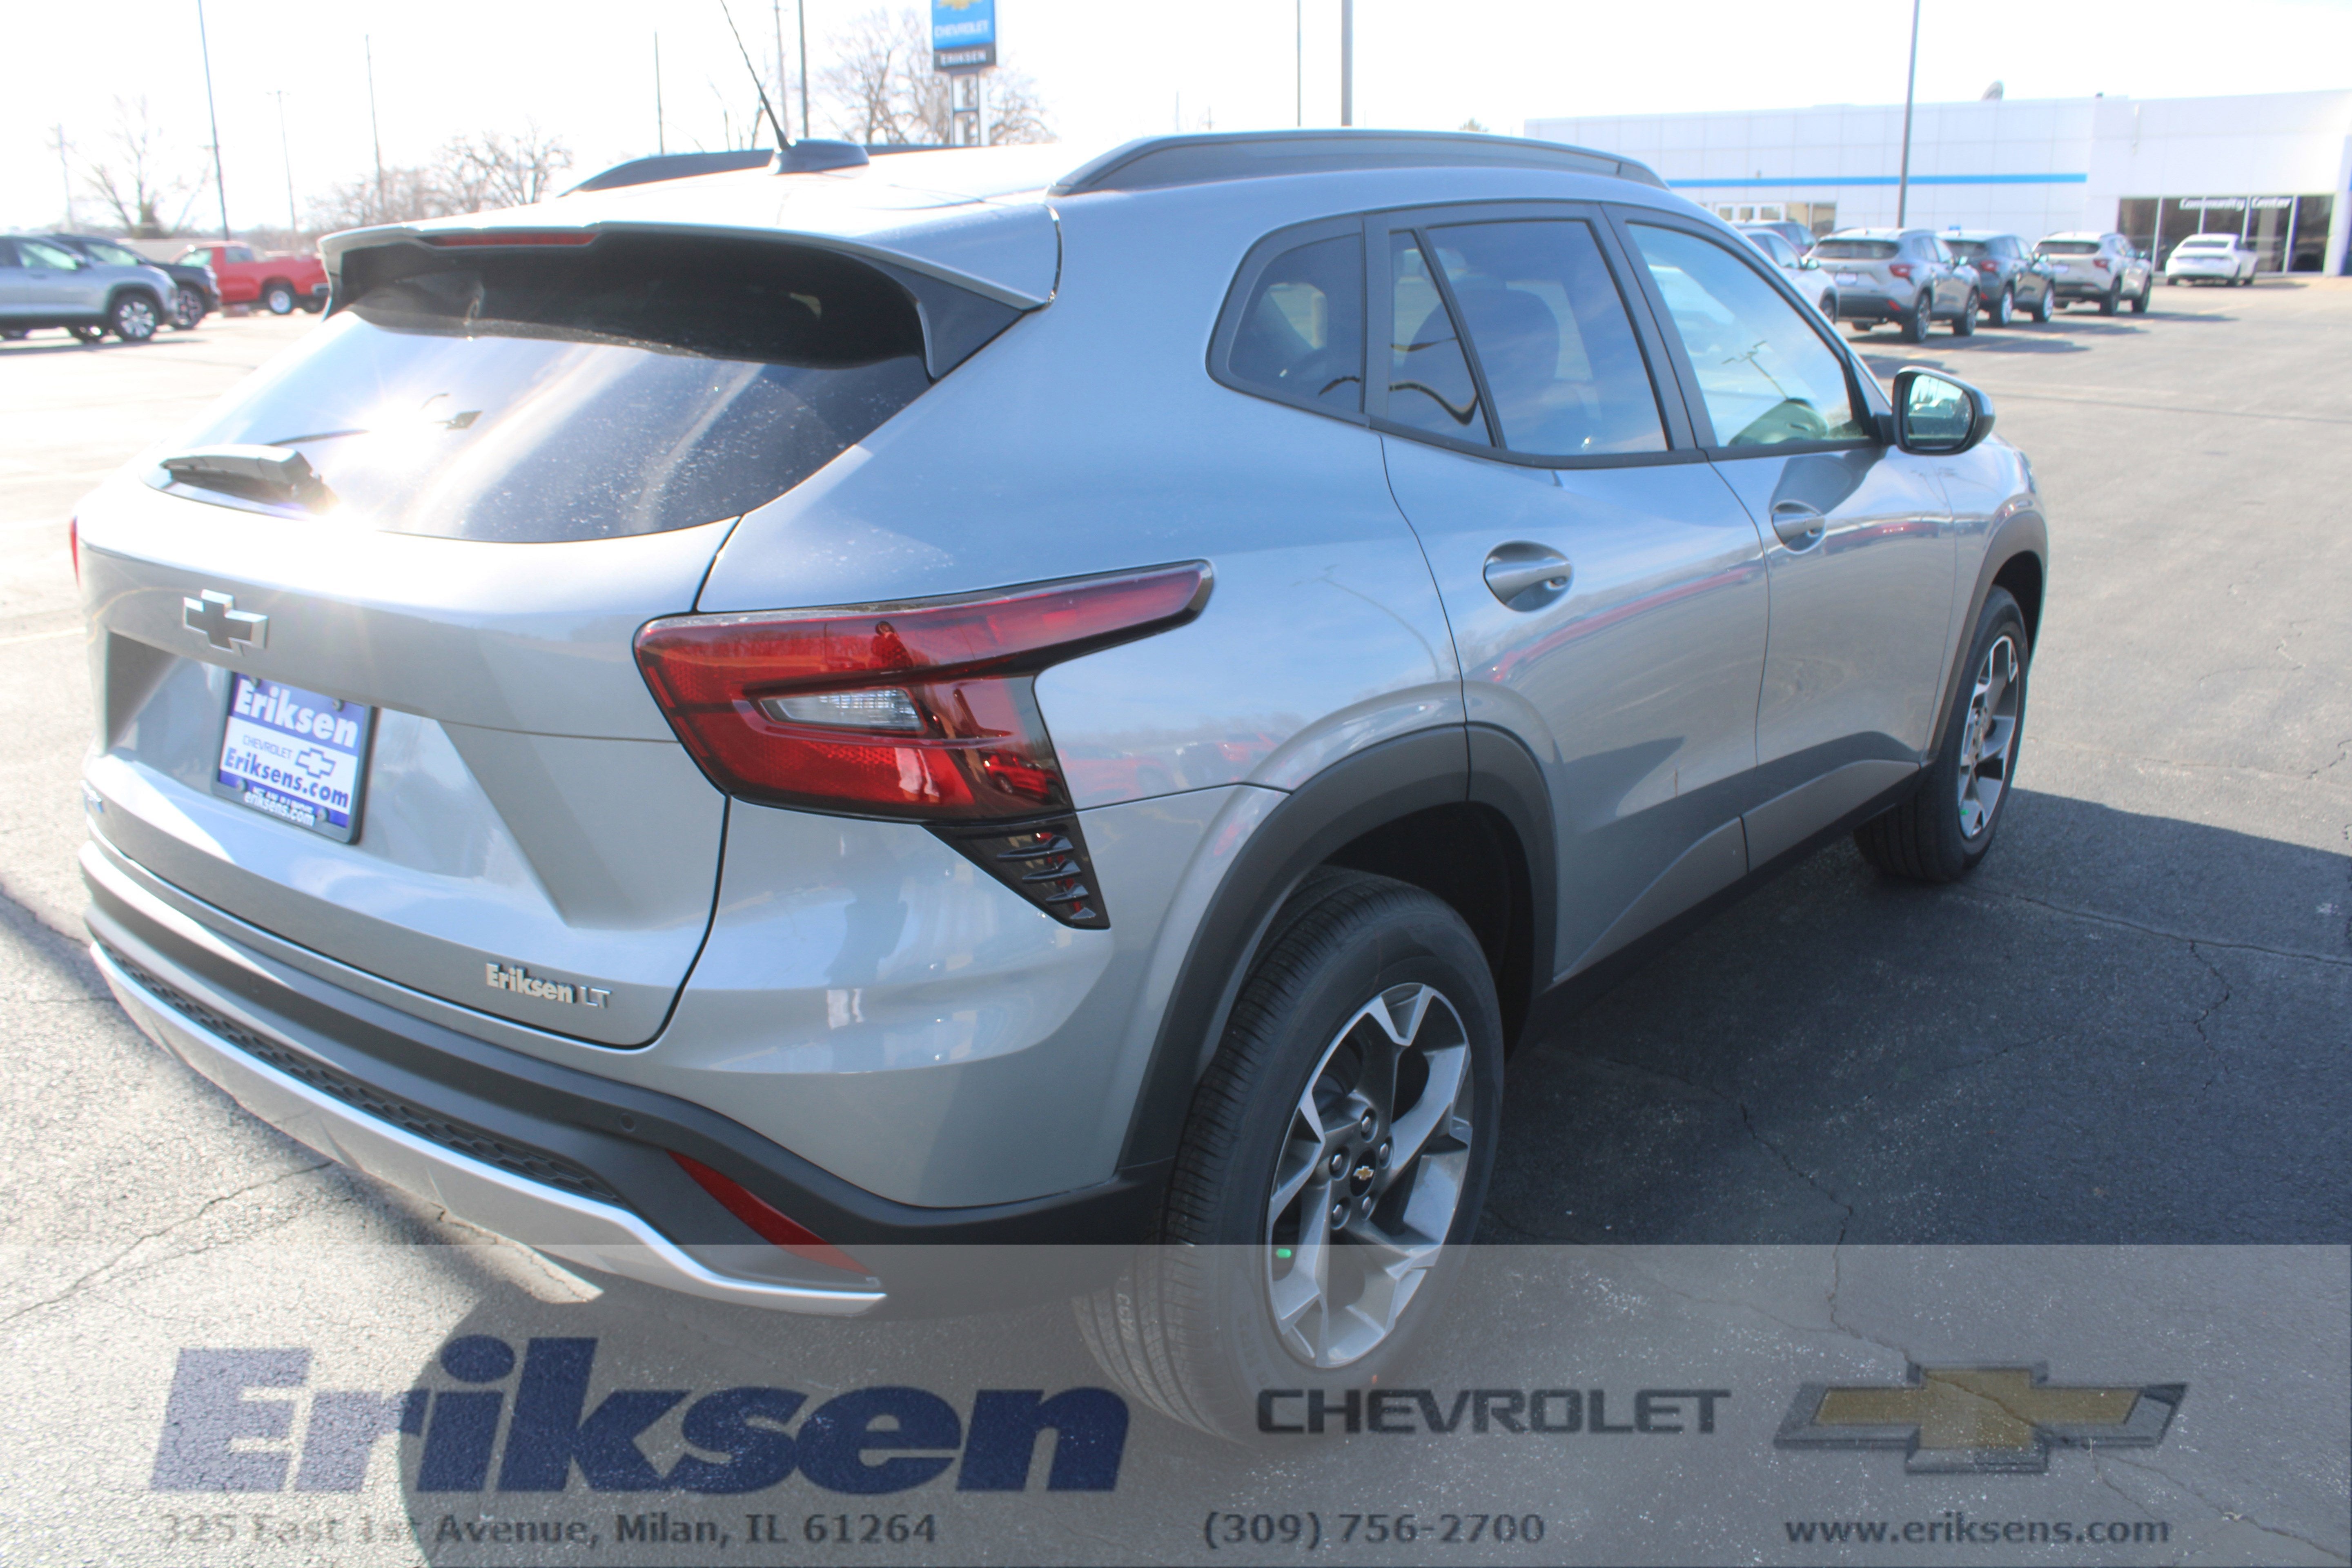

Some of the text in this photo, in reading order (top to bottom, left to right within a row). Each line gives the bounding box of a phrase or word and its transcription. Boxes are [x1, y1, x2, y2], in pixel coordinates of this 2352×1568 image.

[234, 678, 359, 748] Eriksen
[243, 734, 294, 760] CHEVROLET
[224, 747, 349, 808] Eriksens.com
[486, 962, 612, 1009] Eriksen LT
